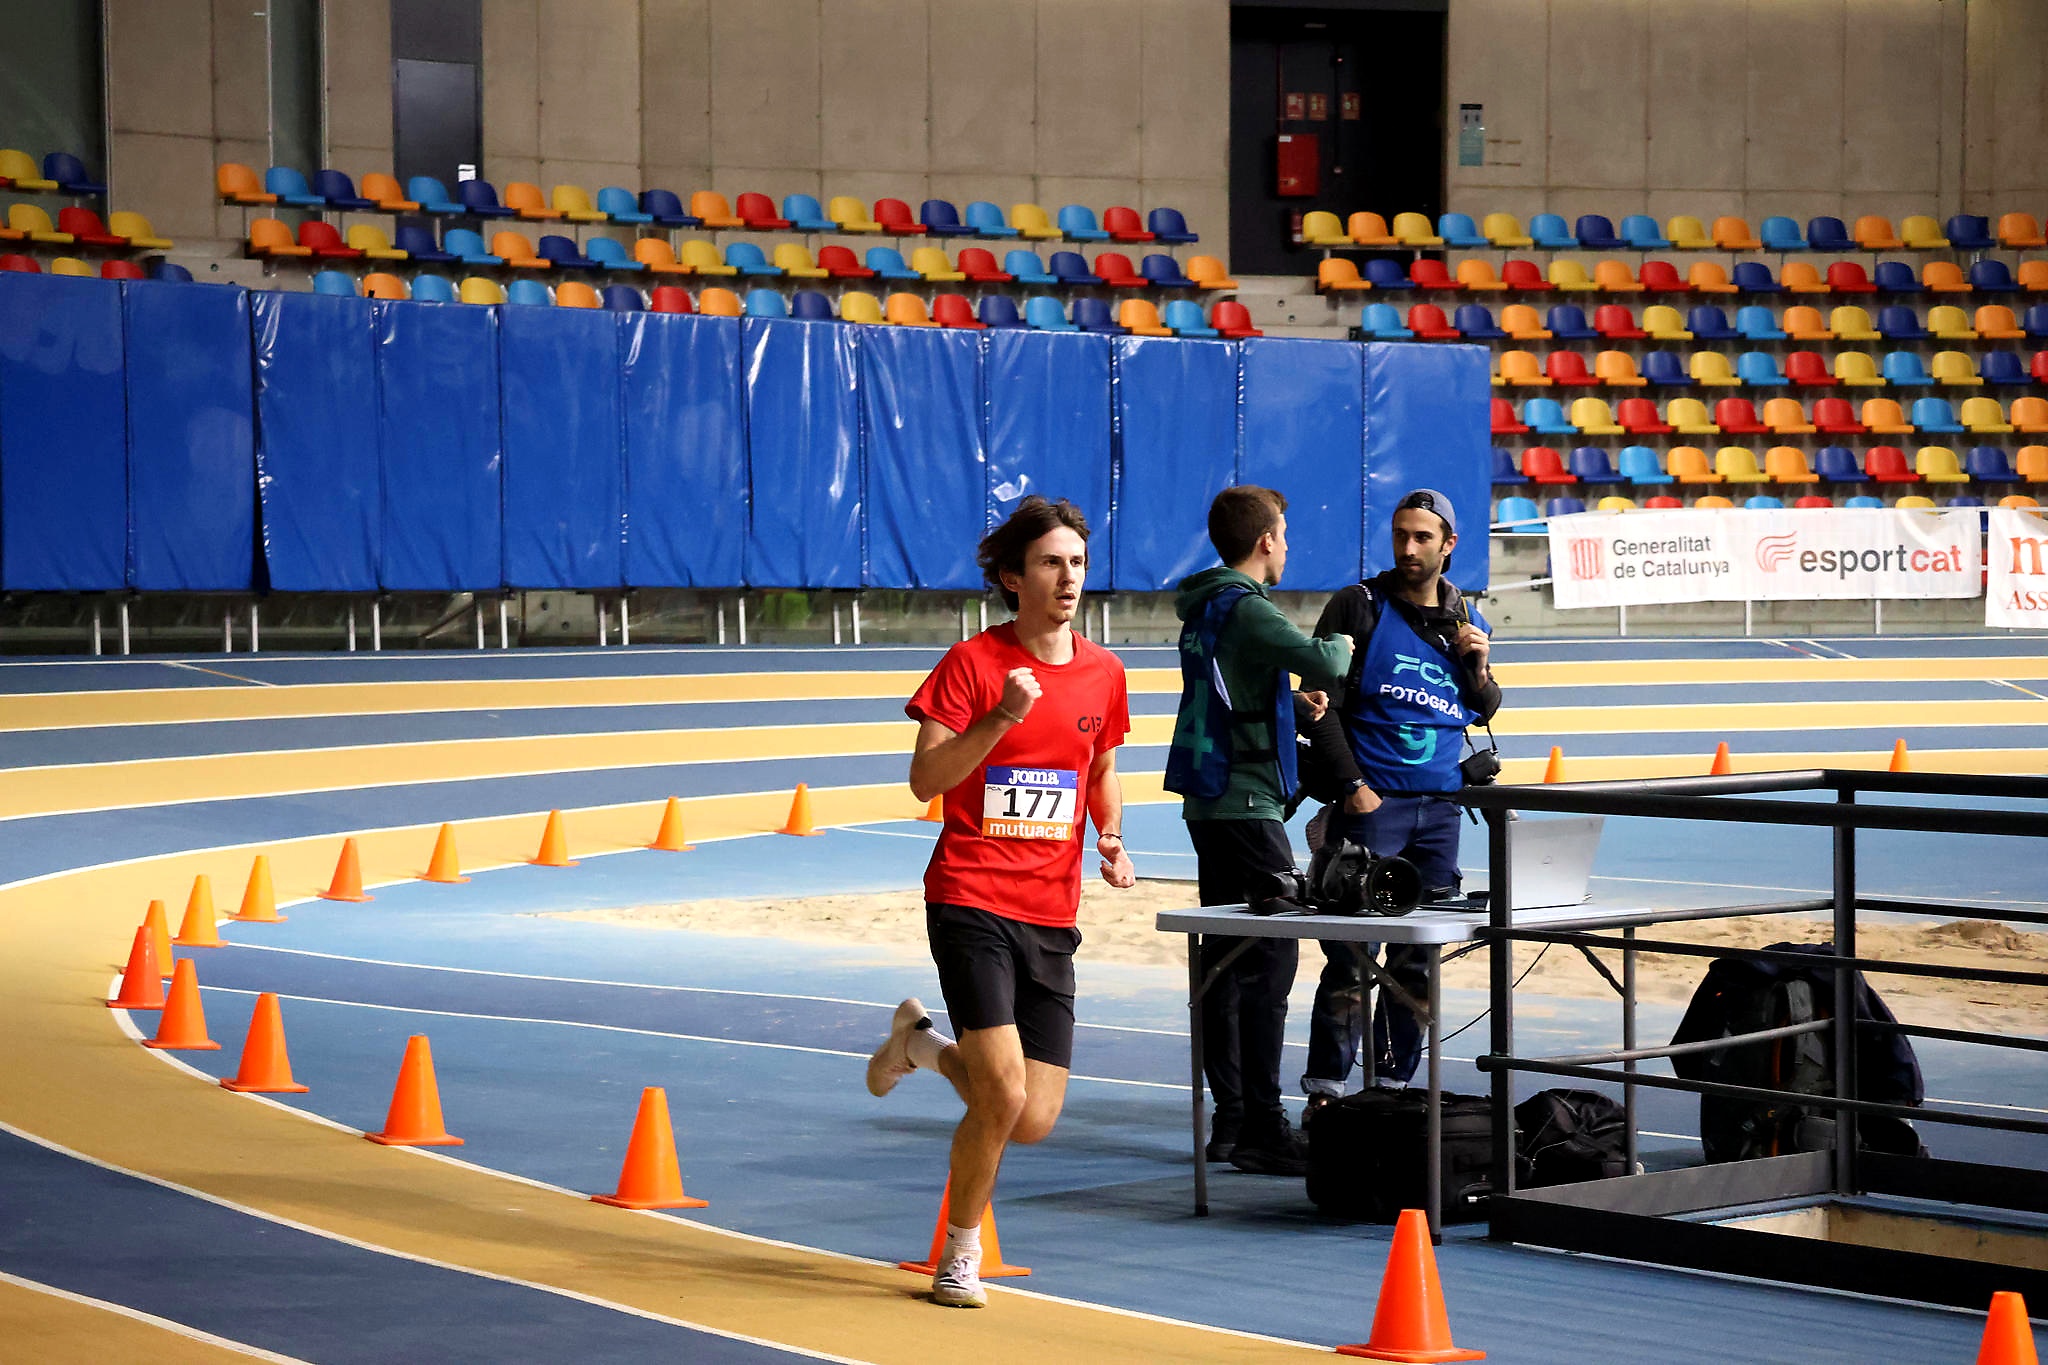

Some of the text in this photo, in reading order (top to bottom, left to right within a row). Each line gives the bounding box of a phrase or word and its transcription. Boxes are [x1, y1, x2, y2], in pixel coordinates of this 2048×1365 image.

[1612, 536, 1711, 556] Generalitat
[1614, 558, 1730, 579] de Catalunya
[1799, 545, 1963, 580] esportcat
[1379, 684, 1463, 720] FOTÒGRA
[1002, 788, 1063, 819] 177
[989, 822, 1069, 839] mutuacat
